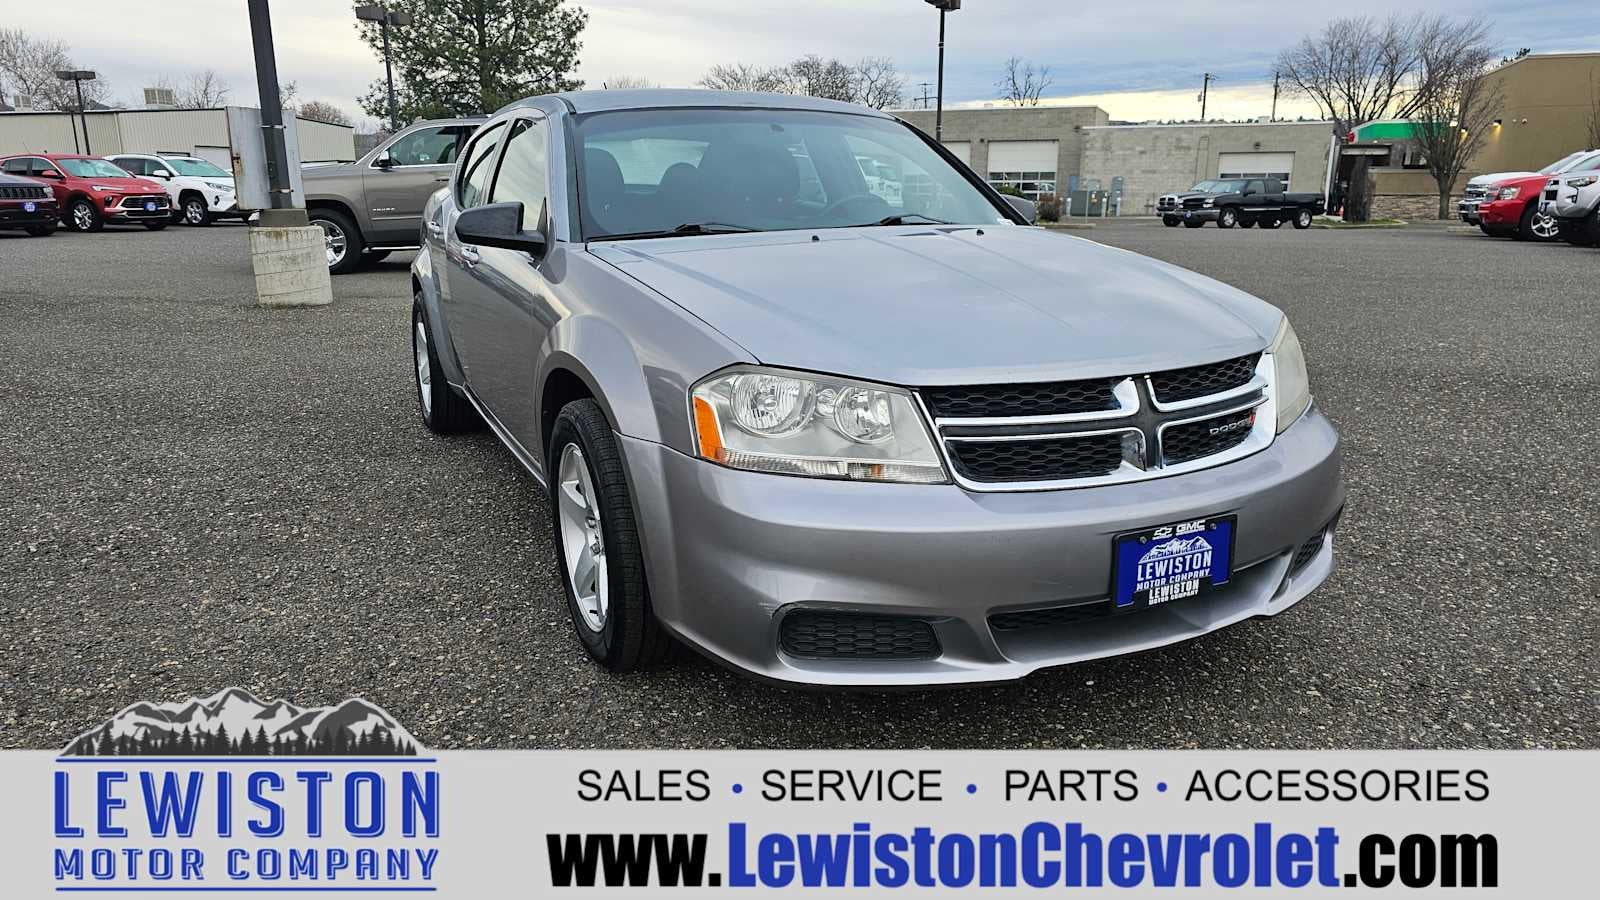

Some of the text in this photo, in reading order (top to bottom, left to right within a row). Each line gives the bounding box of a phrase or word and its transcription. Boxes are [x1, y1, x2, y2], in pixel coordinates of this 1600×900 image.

[1175, 520, 1206, 533] GMC
[1137, 550, 1212, 581] LEWISTON
[1136, 568, 1210, 591] MOTOR COMPANY
[1149, 579, 1200, 600] LEWISTON
[1149, 589, 1199, 606] MOTOR COMPANY
